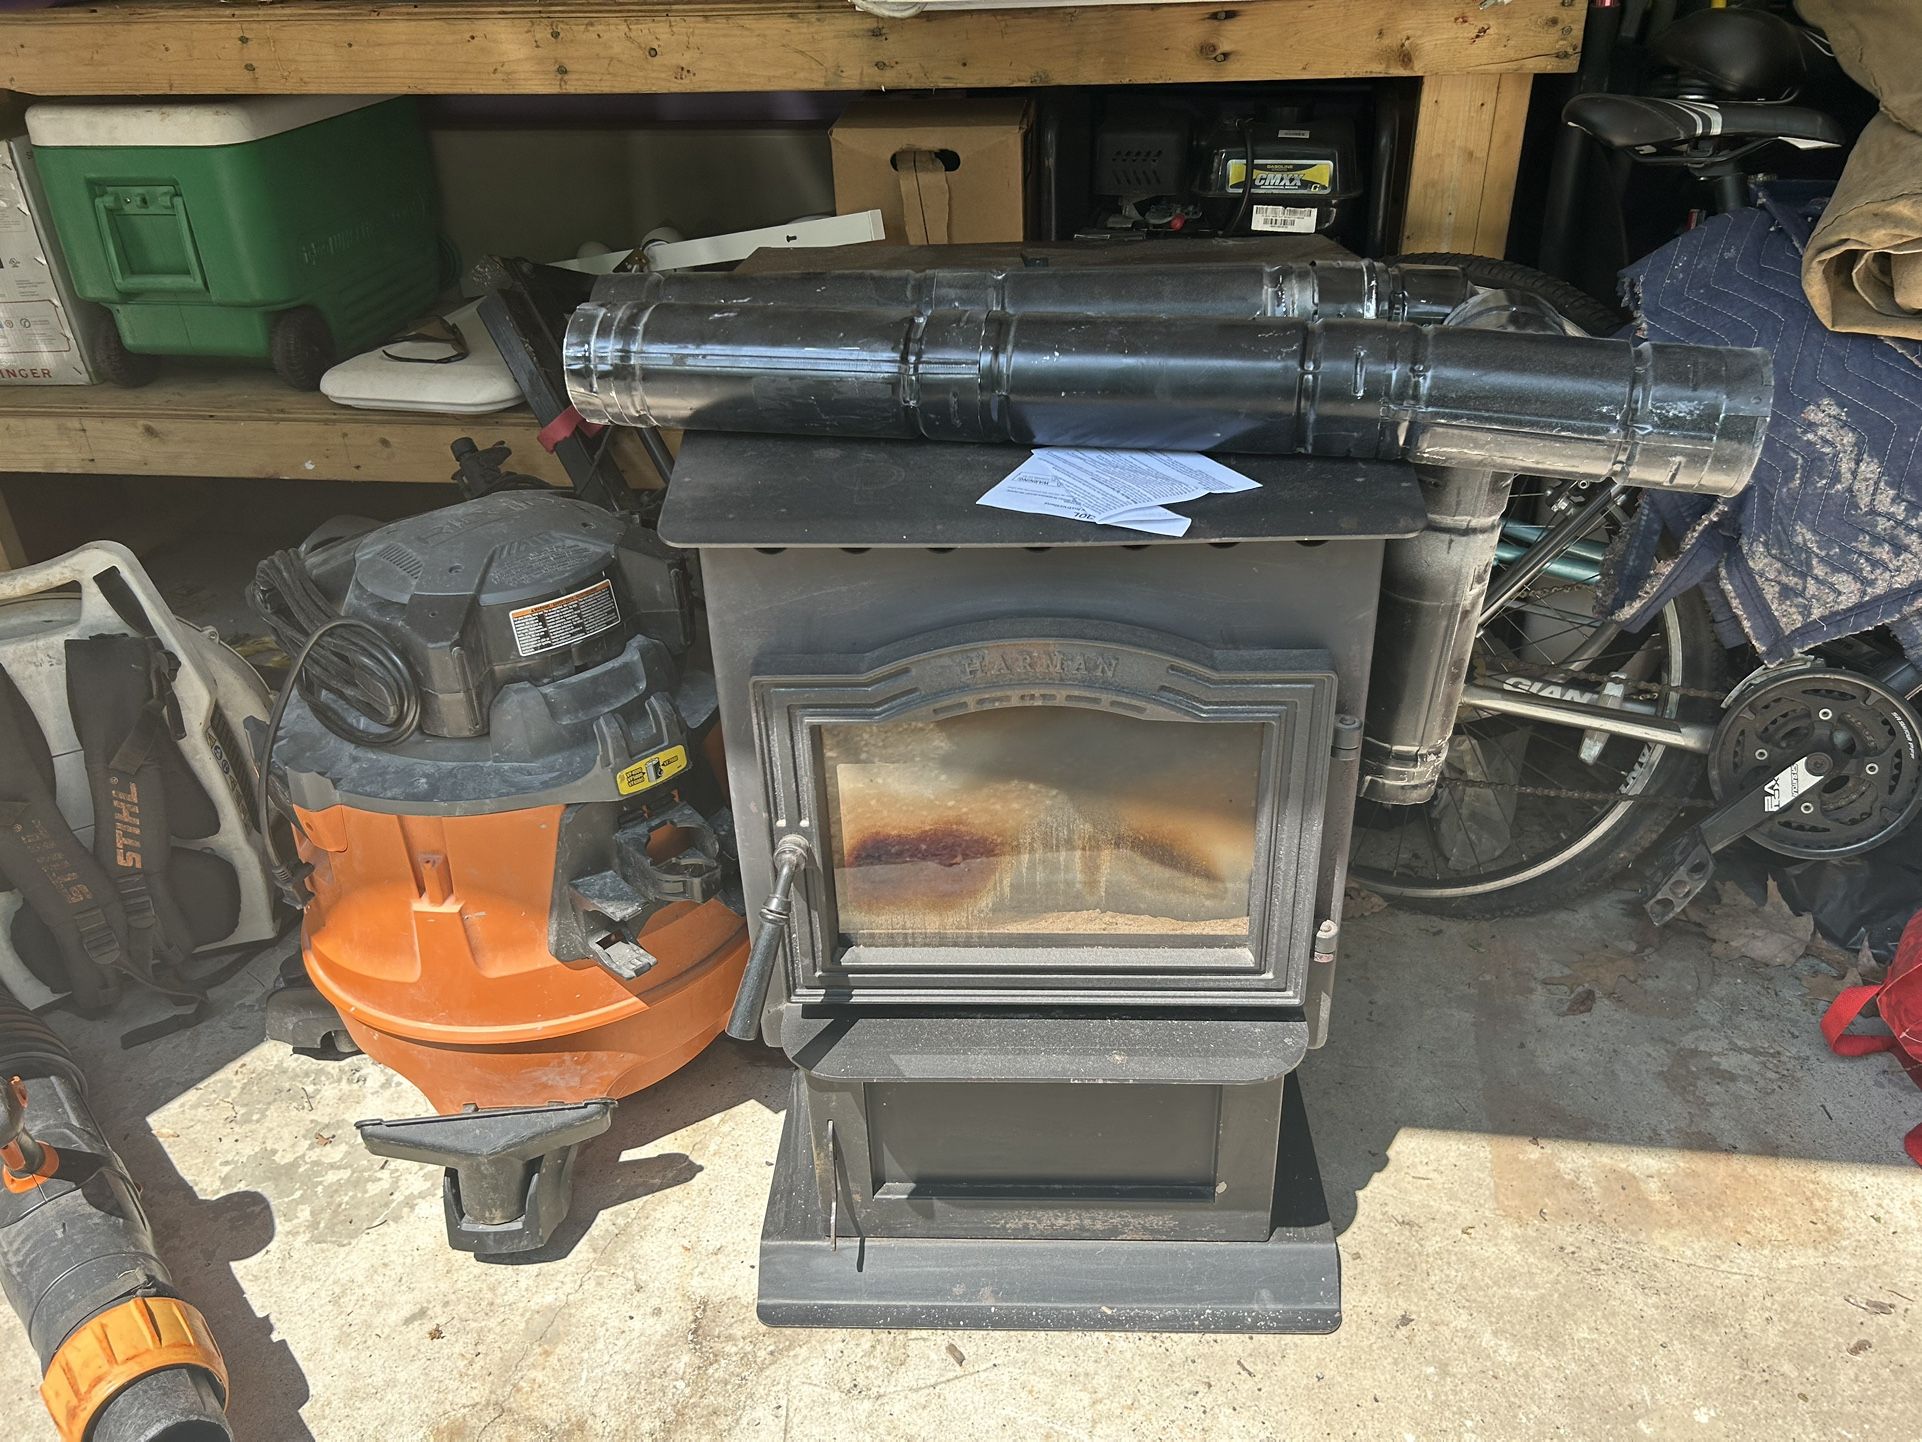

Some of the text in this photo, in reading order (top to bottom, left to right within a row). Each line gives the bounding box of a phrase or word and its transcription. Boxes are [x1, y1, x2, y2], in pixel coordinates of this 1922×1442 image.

[1255, 173, 1303, 186] CMXX
[962, 650, 1119, 680] HARMAN
[1503, 677, 1600, 704] GIAN
[112, 781, 142, 869] STIHL
